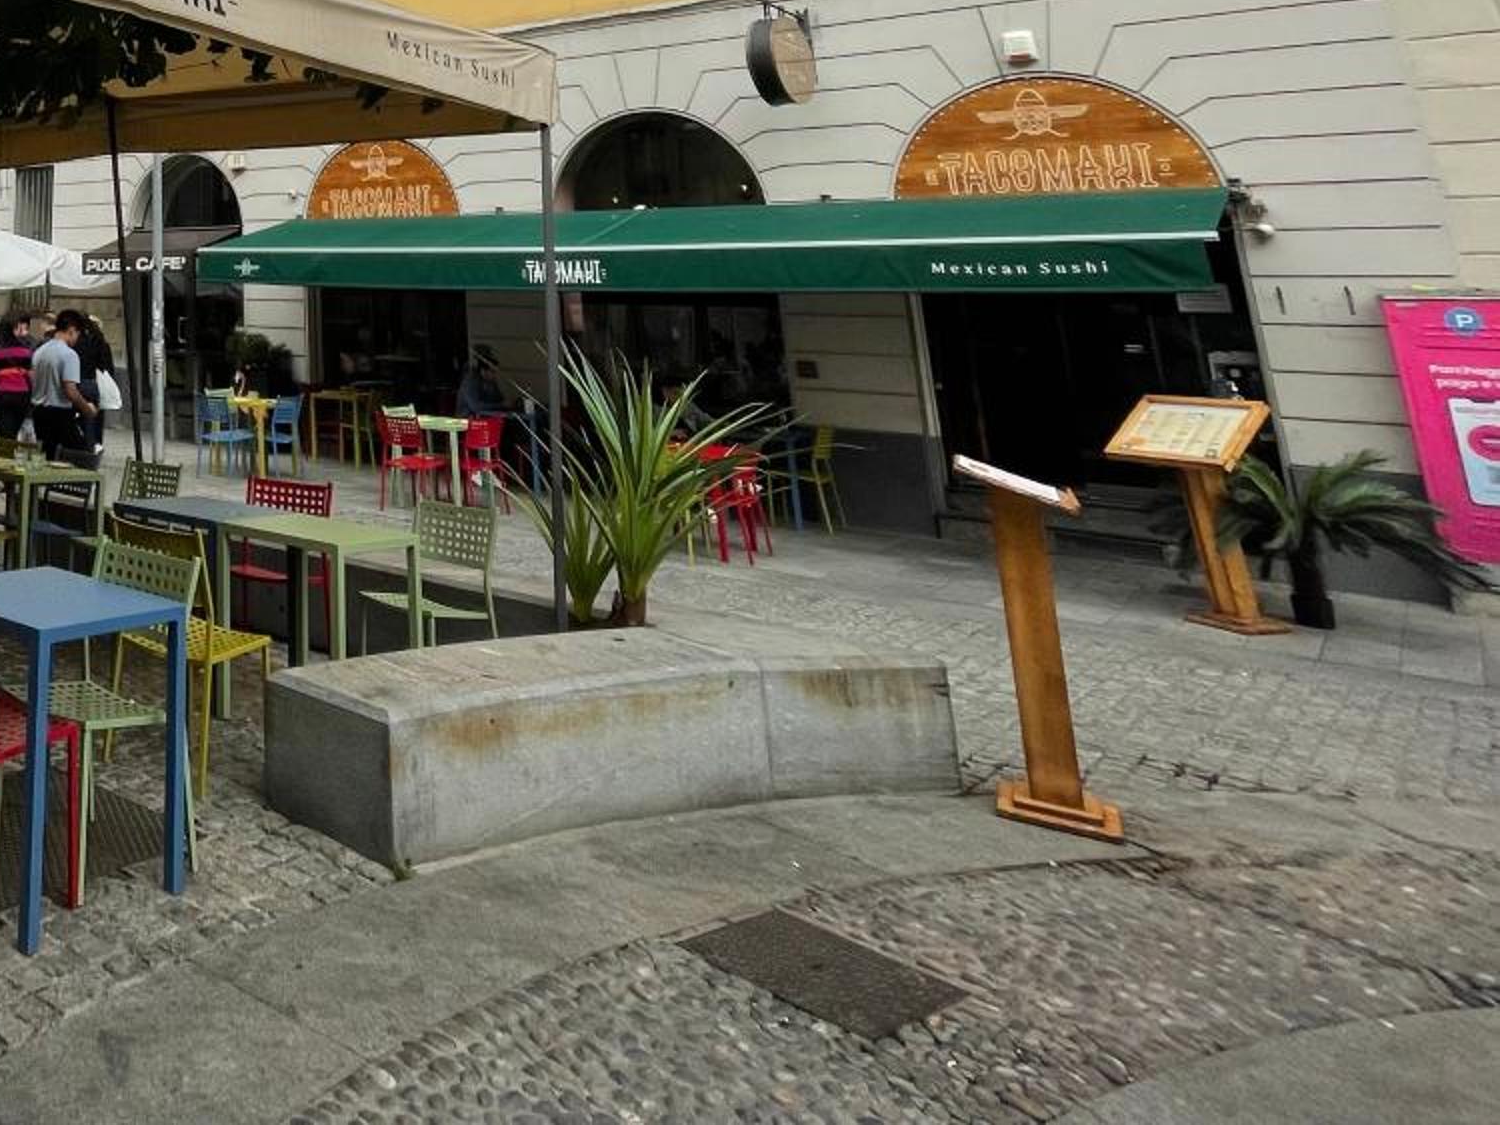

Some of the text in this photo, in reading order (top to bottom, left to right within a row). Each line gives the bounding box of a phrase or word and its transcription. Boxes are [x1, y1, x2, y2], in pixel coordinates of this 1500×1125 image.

[387, 30, 516, 89] Mexican Sushi
[937, 142, 1160, 196] TACOMAKI
[85, 258, 131, 272] PIXE
[931, 260, 1109, 275] Mexican Sushi
[1455, 314, 1474, 328] P
